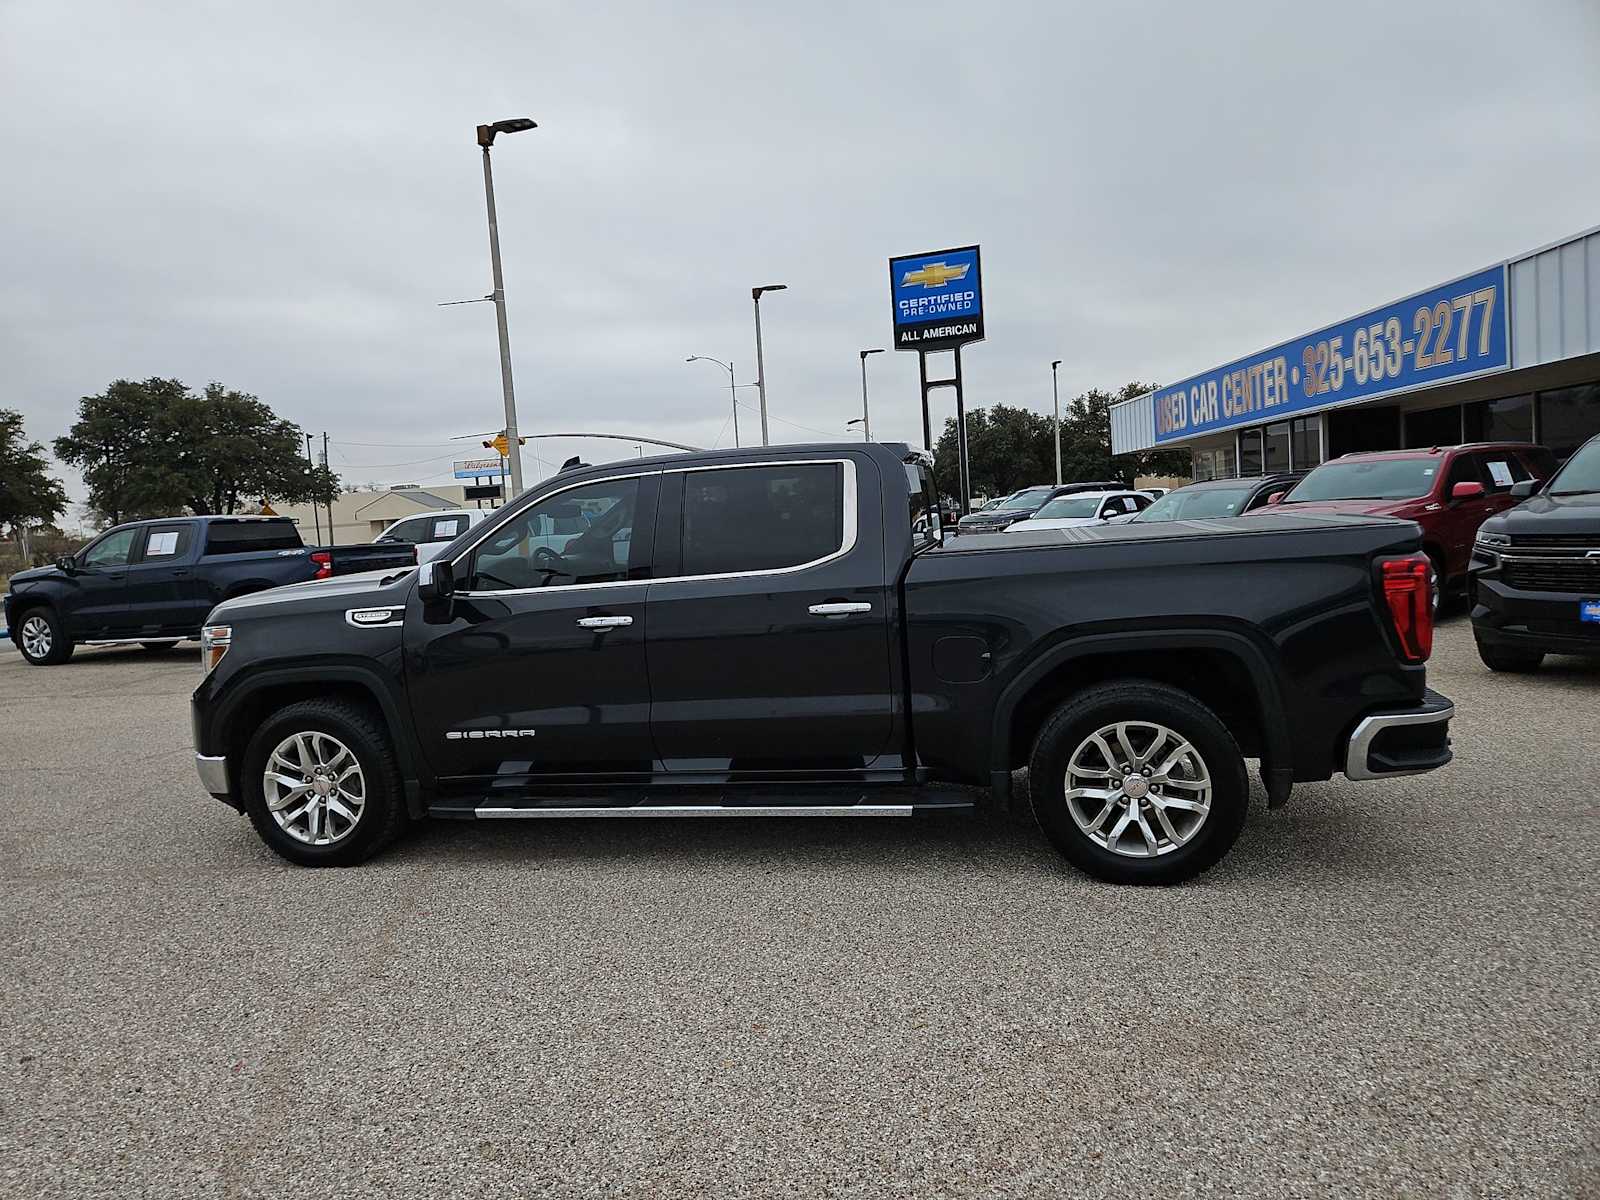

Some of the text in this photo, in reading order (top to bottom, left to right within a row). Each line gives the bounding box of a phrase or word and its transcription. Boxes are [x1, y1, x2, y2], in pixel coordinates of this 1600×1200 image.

[899, 291, 974, 308] CERTIFIED
[903, 301, 971, 317] PRE-OWNED
[901, 323, 977, 342] ALL AMERICAN
[1156, 285, 1496, 435] USED CAR CENTER 325-653-2277
[446, 730, 535, 739] SIERRA
